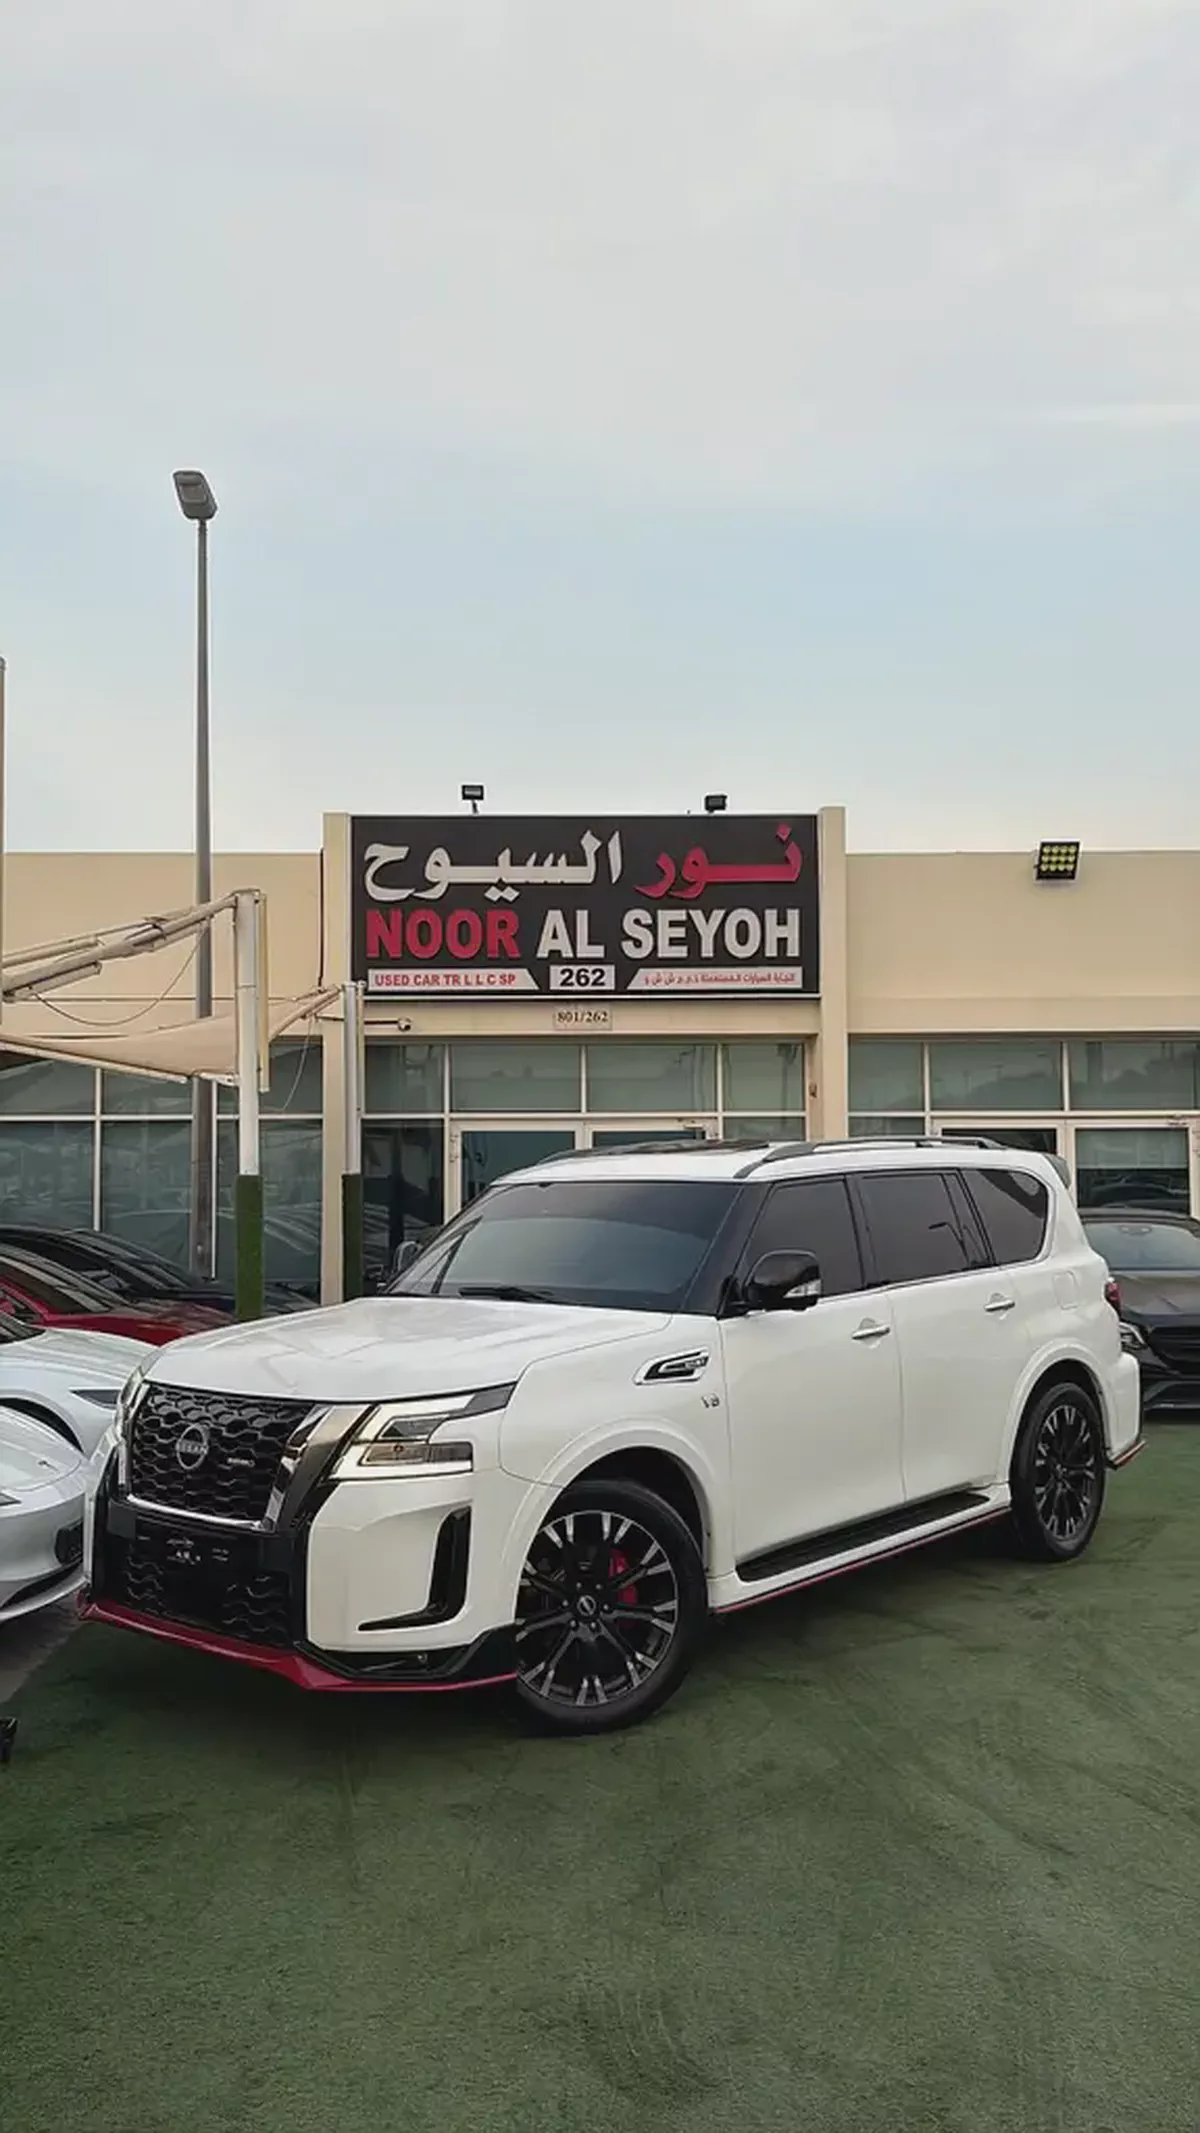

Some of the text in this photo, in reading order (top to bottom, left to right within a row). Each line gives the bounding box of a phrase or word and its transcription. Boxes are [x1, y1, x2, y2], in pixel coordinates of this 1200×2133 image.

[364, 823, 802, 902] نور السيوح
[366, 908, 800, 959] NOOR AL SEYOH
[375, 974, 410, 986] USED
[413, 974, 441, 986] CAR
[443, 974, 462, 986] TR
[499, 973, 516, 985] SP
[560, 968, 606, 987] 262
[557, 1011, 608, 1023] 801/262
